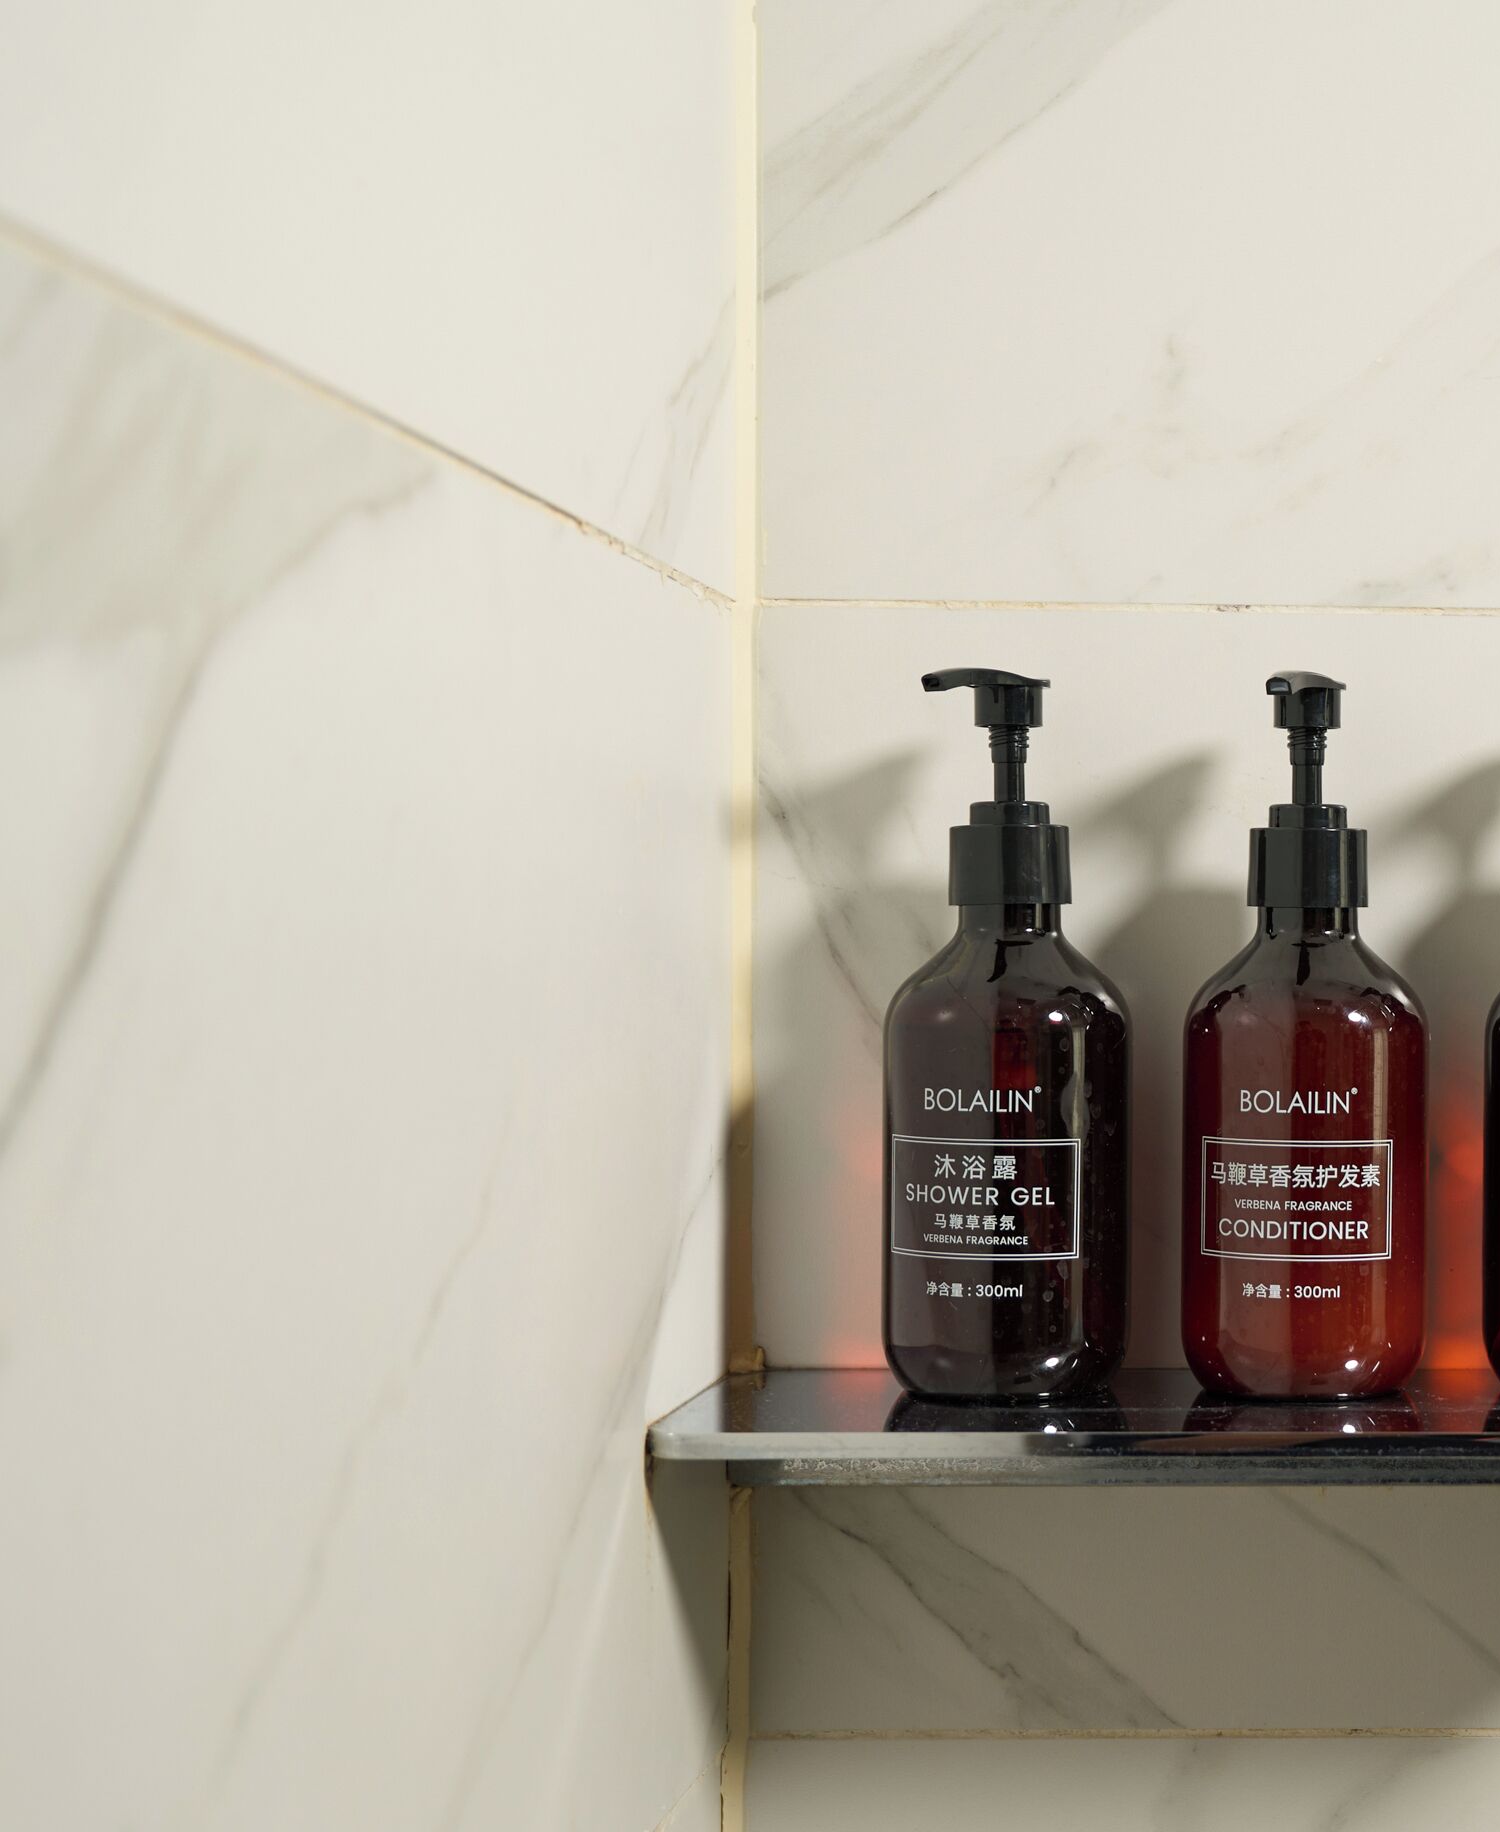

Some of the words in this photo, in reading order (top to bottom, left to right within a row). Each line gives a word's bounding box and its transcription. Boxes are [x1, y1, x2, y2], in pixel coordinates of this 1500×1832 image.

[934, 1153, 1018, 1180] 沐浴露
[1211, 1161, 1381, 1189] 马鞭草香氛护发素
[905, 1182, 999, 1206] SHOWER
[1010, 1186, 1055, 1206] GEL
[1234, 1198, 1281, 1211] VERBENA
[1284, 1200, 1353, 1211] FRAGRANCE
[933, 1213, 1016, 1231] 马鞭草香氛
[1218, 1217, 1369, 1241] CONDITIONER
[923, 1233, 964, 1244] VERBENA
[965, 1235, 1029, 1246] FRAGRANCE
